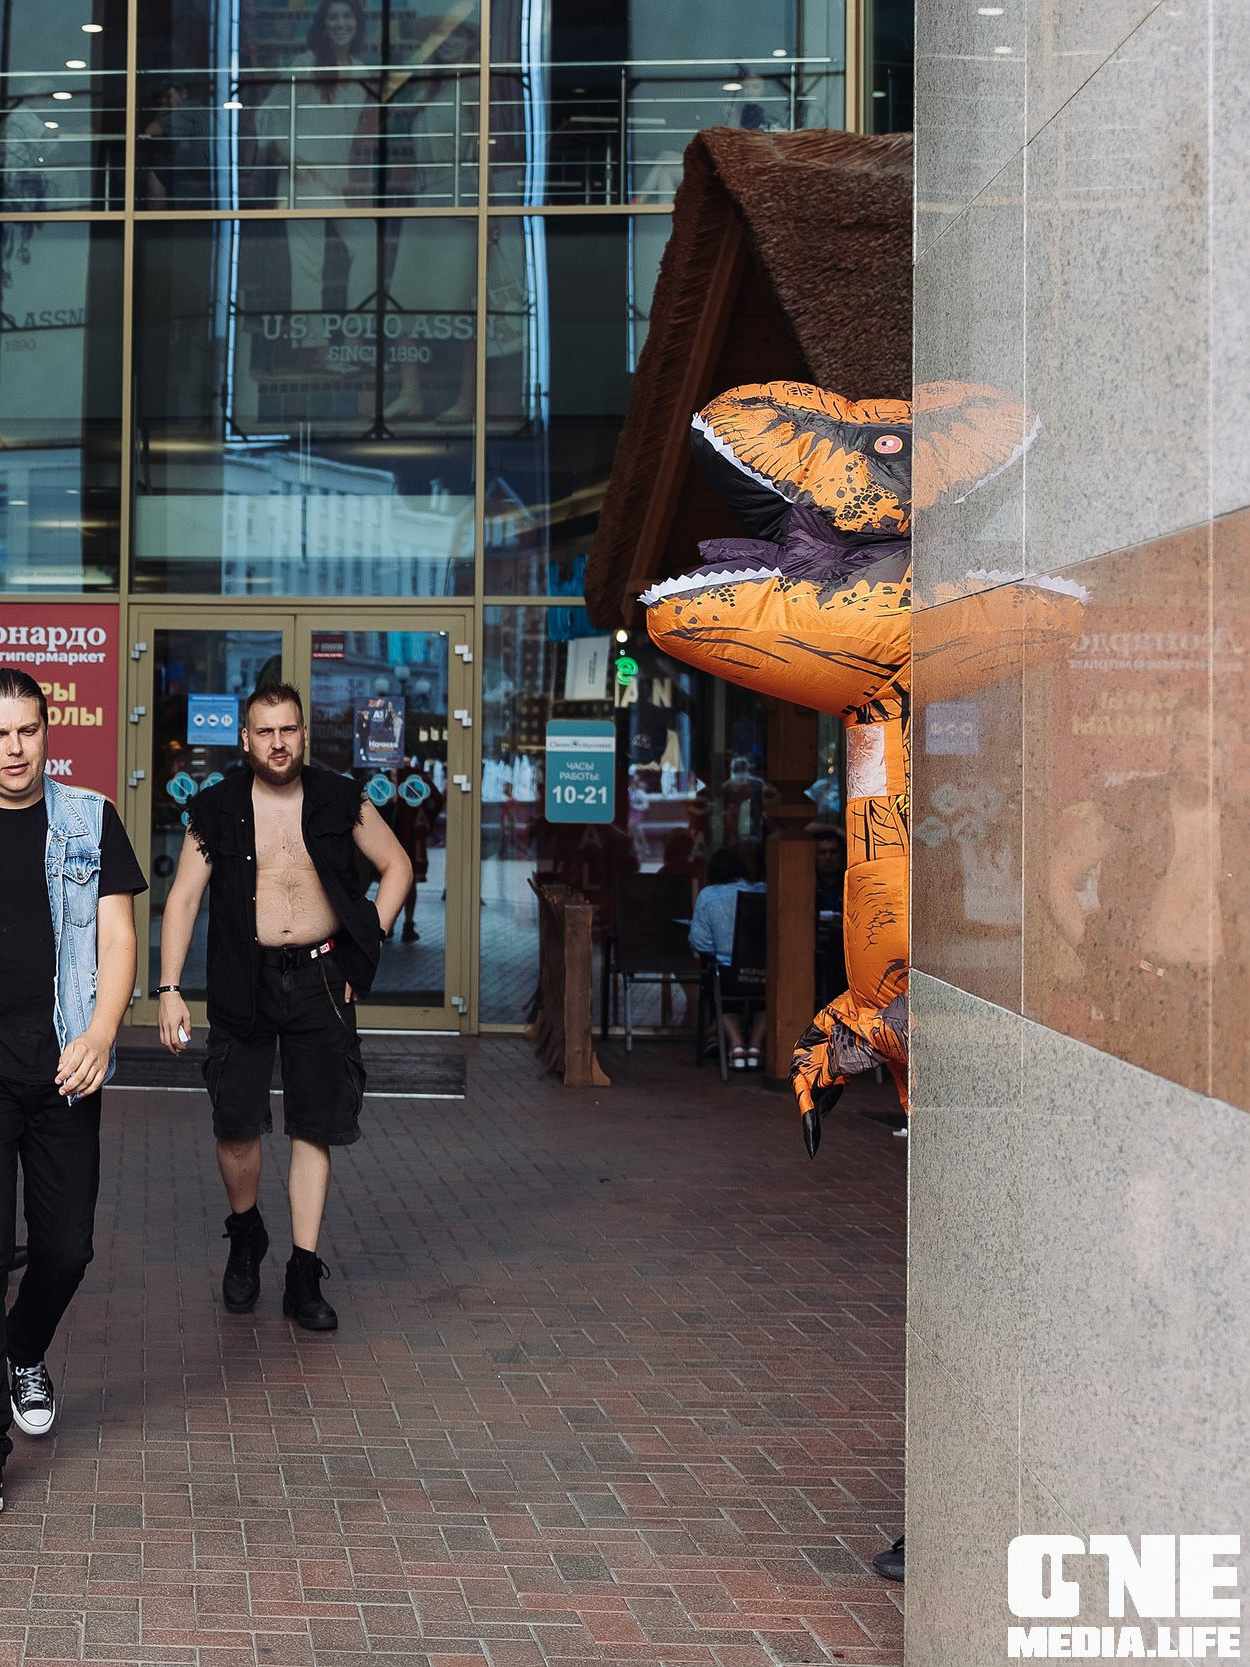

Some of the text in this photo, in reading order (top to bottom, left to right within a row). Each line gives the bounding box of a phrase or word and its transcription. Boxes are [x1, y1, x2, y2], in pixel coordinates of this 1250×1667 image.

[388, 346, 432, 363] 1890
[48, 707, 103, 726] ОЛЫ
[566, 762, 595, 771] ЧАСЫ
[552, 785, 607, 804] 10-21
